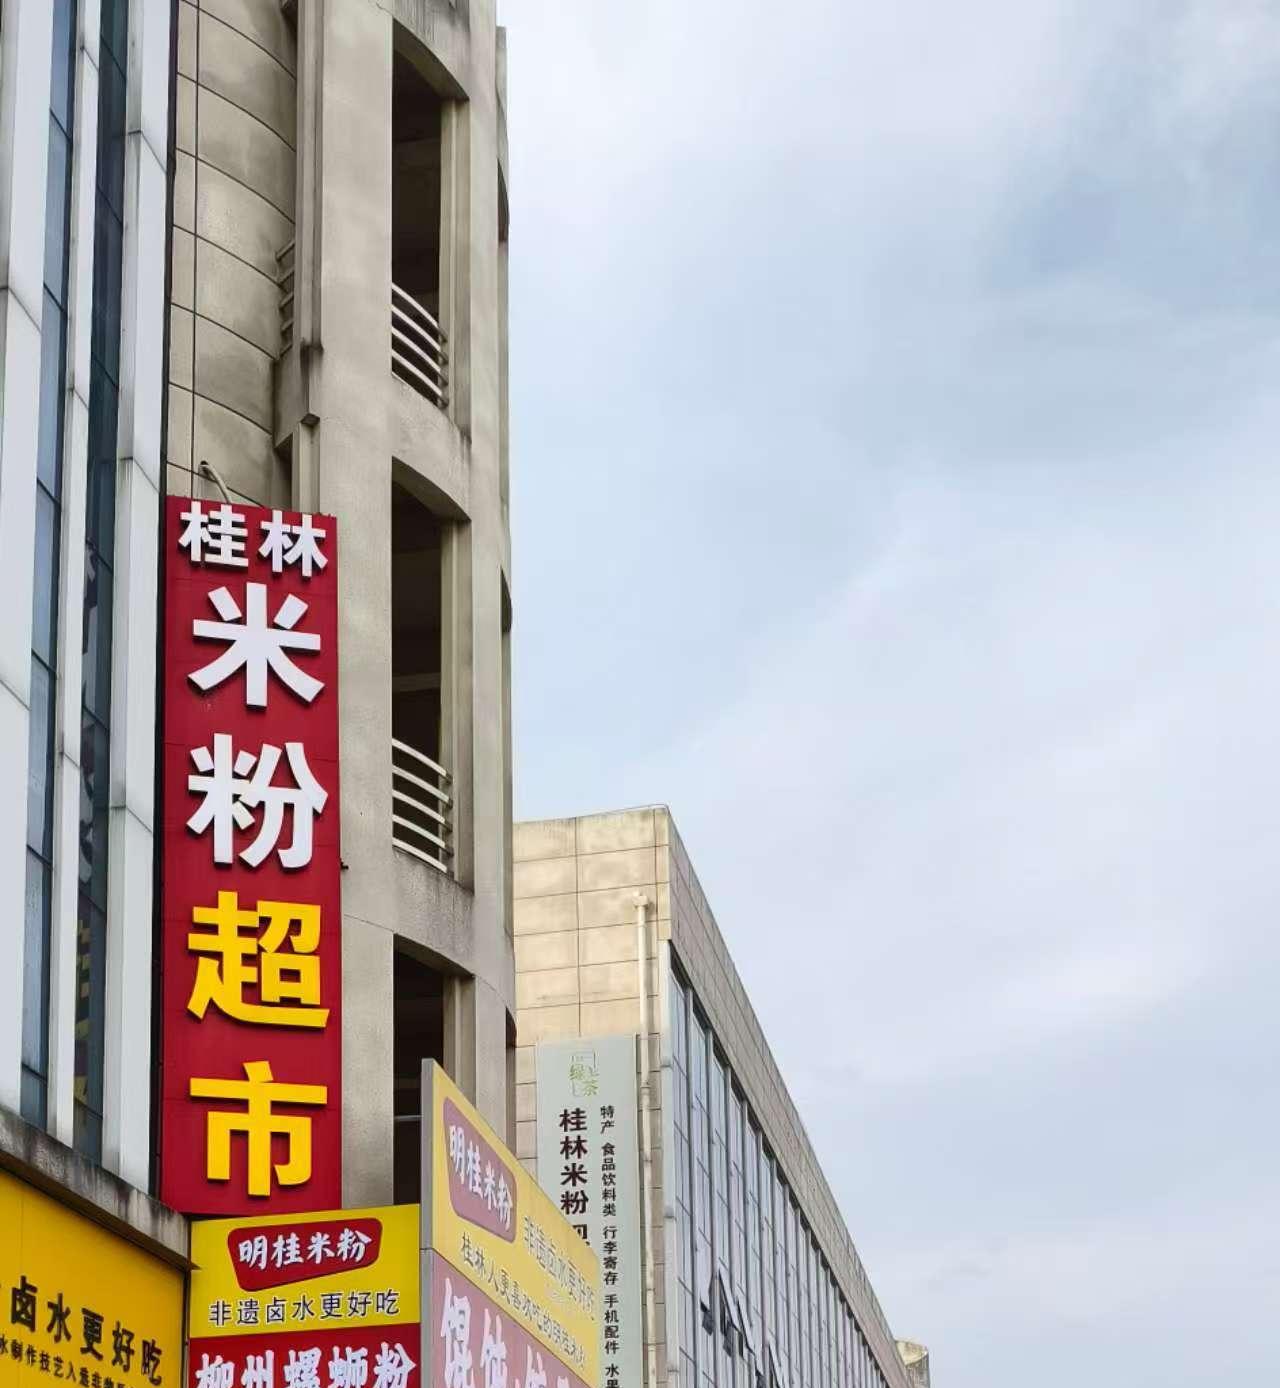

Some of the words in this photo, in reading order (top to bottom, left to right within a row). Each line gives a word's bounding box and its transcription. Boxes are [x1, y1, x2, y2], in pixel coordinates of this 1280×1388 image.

[179, 501, 329, 577] 桂林
[187, 581, 330, 1197] 米粉超市
[600, 1105, 615, 1135] 特产
[449, 1125, 513, 1231] 明桂米粉
[601, 1142, 617, 1217] 食品饮料类
[238, 1228, 373, 1270] 明桂米粉
[602, 1226, 619, 1286] 行李寄存
[11, 1275, 162, 1386] 卤水更好吃
[209, 1289, 400, 1327] 非遗卤水更好吃
[603, 1294, 620, 1355] 手机配件
